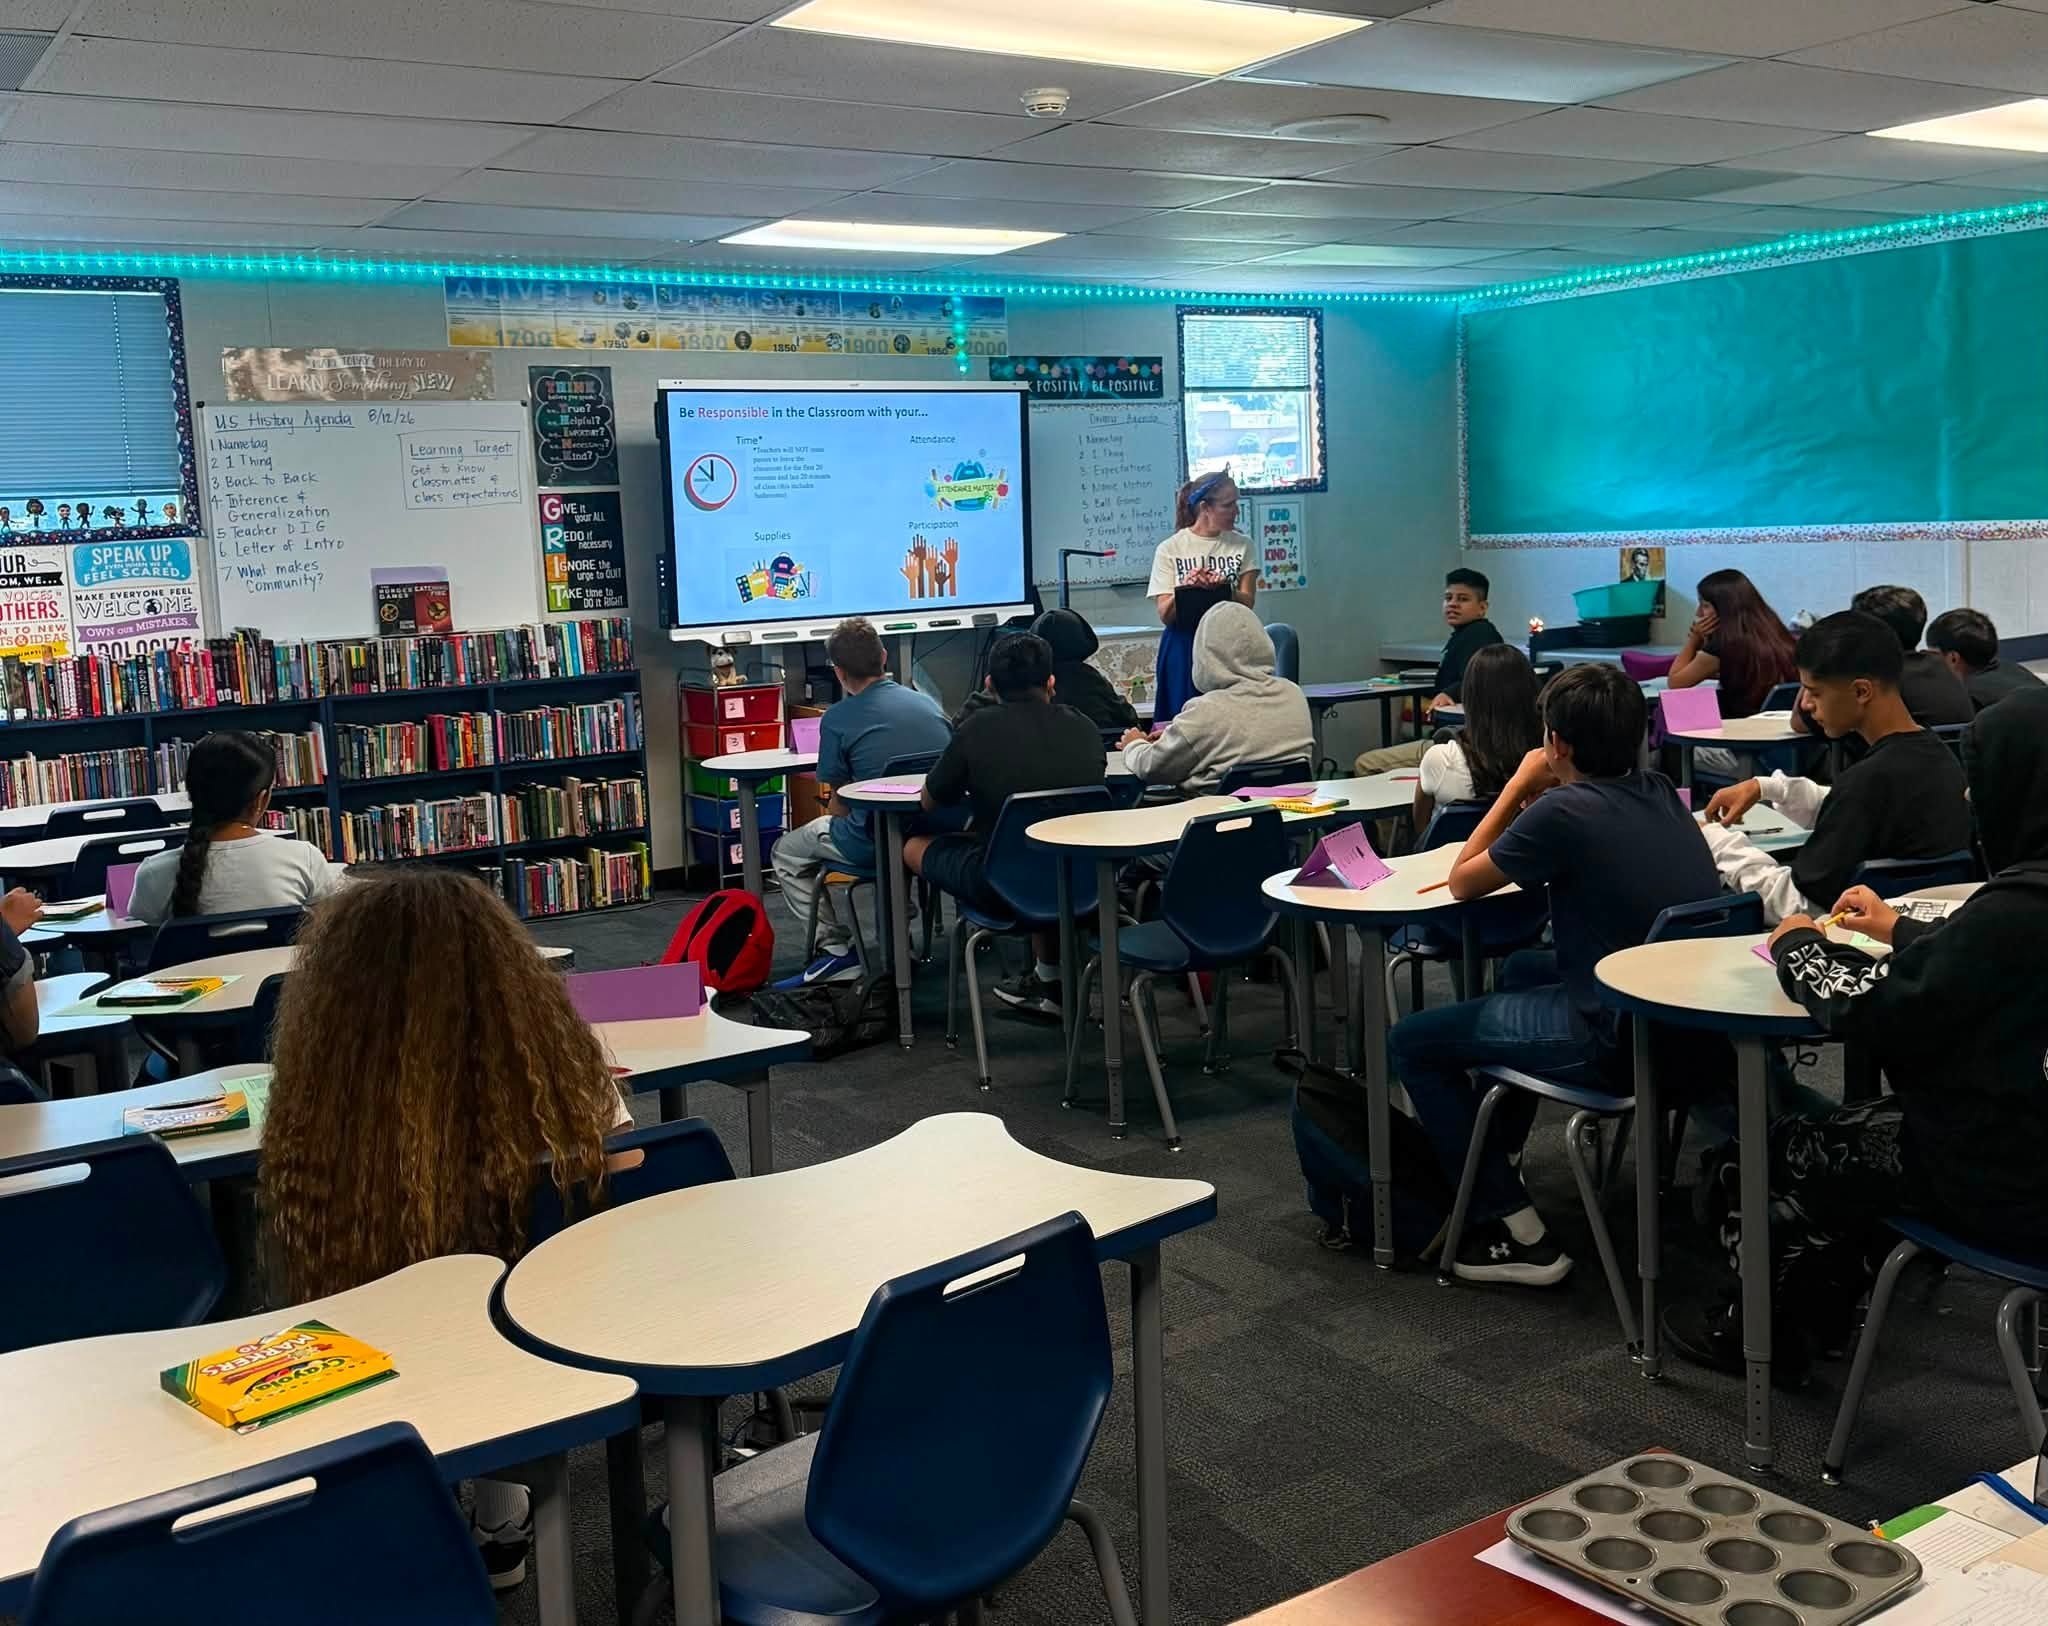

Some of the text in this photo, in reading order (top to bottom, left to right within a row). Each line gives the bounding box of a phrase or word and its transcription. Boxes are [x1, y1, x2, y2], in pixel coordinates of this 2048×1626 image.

[601, 339, 629, 349] 1750
[773, 343, 798, 353] 1850
[844, 338, 889, 354] 1900
[266, 373, 326, 392] LEARN
[411, 372, 457, 393] NEW
[248, 411, 295, 435] History
[303, 409, 353, 432] Agenda
[367, 408, 416, 425] 8/12/26
[679, 405, 929, 421] Be Responsible in the Classroom with your...
[910, 435, 956, 444] Attendance
[410, 439, 514, 463] Learning Target
[211, 458, 219, 469] 2
[240, 454, 273, 471] Thing
[410, 463, 450, 476] Get to
[211, 472, 320, 489] 3 Back to Back
[210, 495, 223, 510] 4
[226, 493, 289, 508] Inference
[414, 487, 519, 505] class expectations
[228, 505, 331, 523] Generalization
[216, 527, 226, 539] 5
[232, 524, 278, 538] Teacher
[316, 520, 326, 532] G
[908, 520, 959, 530] Participation
[754, 531, 792, 542] Supplies
[1268, 537, 1281, 546] are
[91, 544, 173, 566] SPEAK UP
[219, 537, 345, 558] 6 Letter of Intro
[1264, 548, 1288, 562] KIND
[0, 554, 27, 574] UR
[553, 555, 597, 579] IGNORE
[1175, 553, 1243, 571] BULLDOGS
[83, 566, 188, 585] FEEL SCARED.
[219, 559, 320, 583] 7 What makes
[576, 571, 594, 581] urge
[596, 570, 605, 579] to
[23, 576, 58, 585] WE...
[246, 572, 325, 594] Community?
[4, 590, 54, 603] VOICES
[75, 587, 193, 602] MAKE EVERYONE FEEL
[551, 584, 583, 608] TAKE
[605, 587, 614, 597] to
[14, 627, 32, 635] TO
[37, 624, 68, 634] NEW
[86, 616, 193, 639] OWN MISTAKES.
[30, 633, 71, 645] IDEAS
[201, 1333, 318, 1377] MARKERS
[254, 1357, 347, 1394] Crayola
